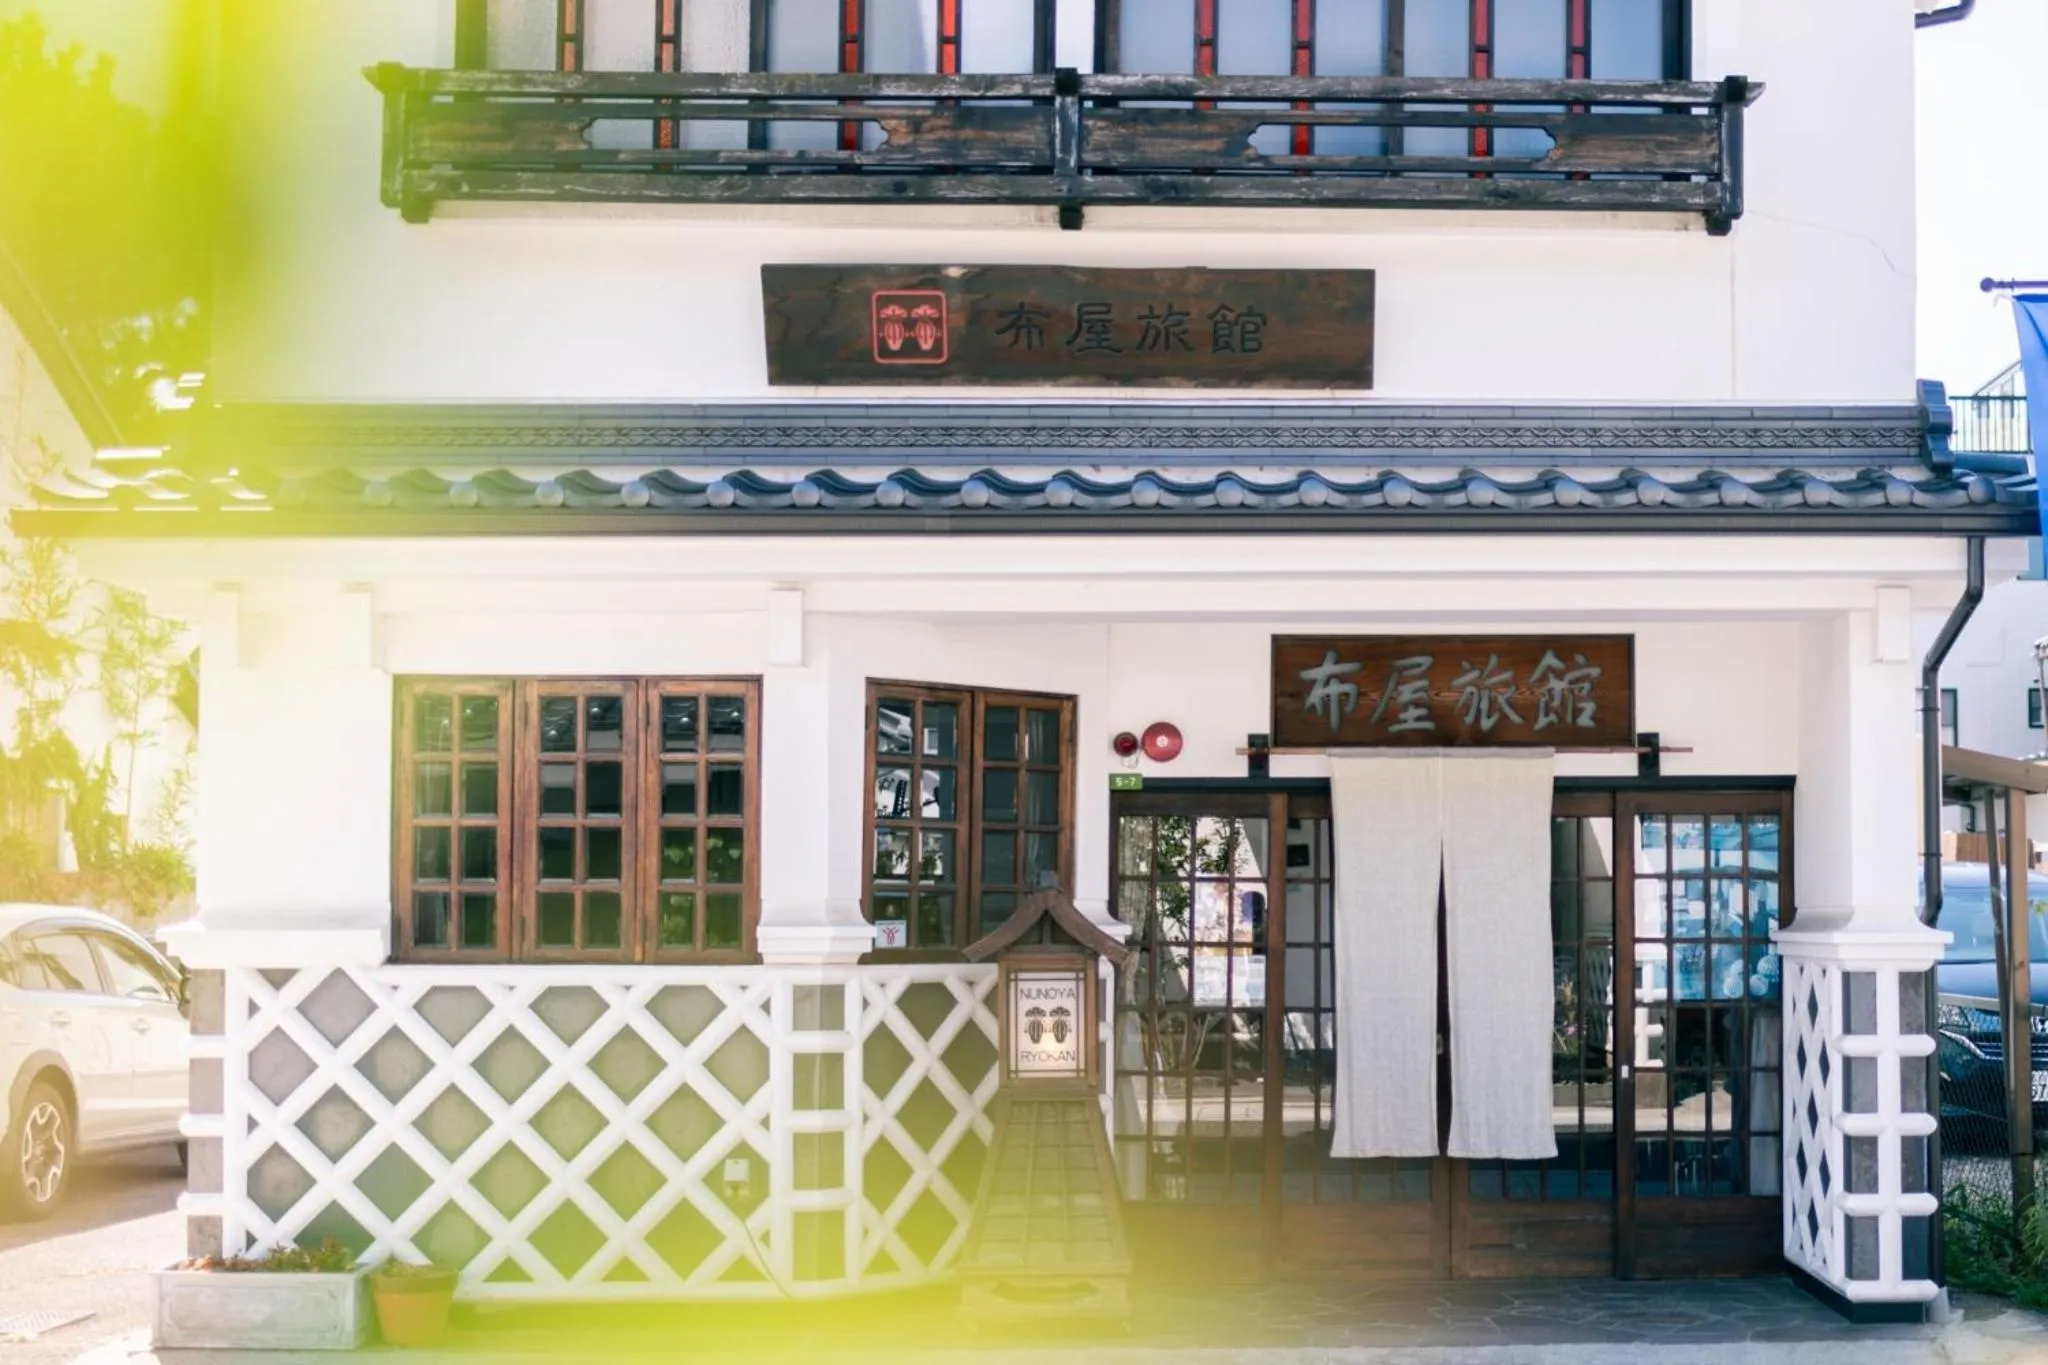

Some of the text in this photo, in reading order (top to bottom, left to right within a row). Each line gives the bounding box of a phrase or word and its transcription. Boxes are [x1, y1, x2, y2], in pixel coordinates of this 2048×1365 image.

[996, 301, 1270, 354] 布屋旅館
[1299, 649, 1602, 732] 布屋旅館
[1020, 987, 1076, 1000] NUNOYA
